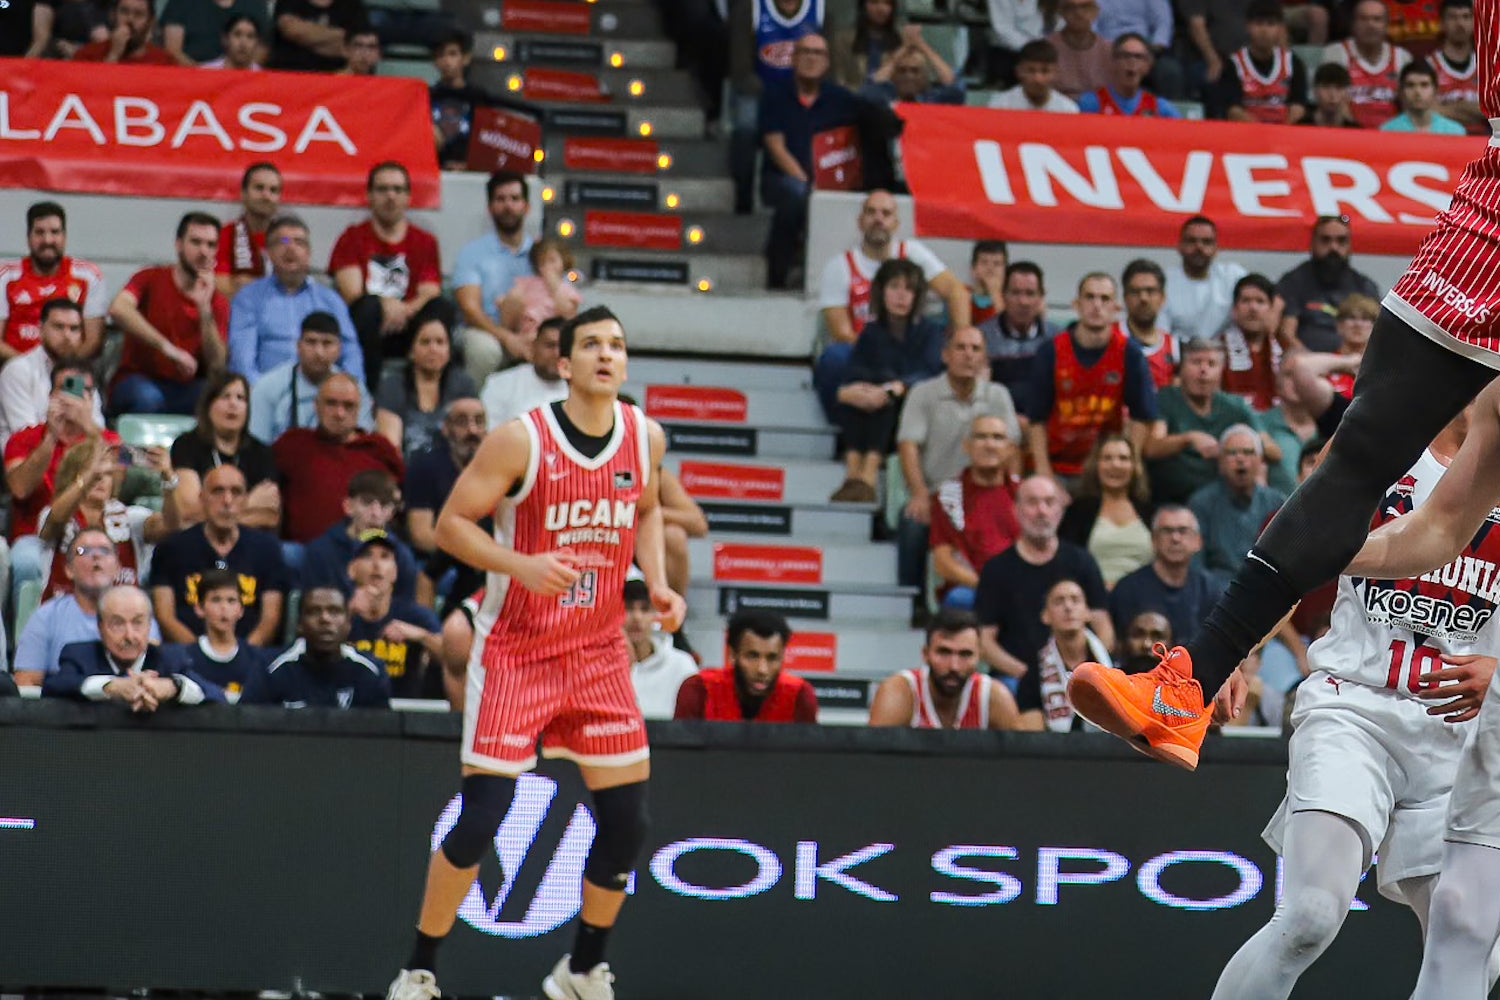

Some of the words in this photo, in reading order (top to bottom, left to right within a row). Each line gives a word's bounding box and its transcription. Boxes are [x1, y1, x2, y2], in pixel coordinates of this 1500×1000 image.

[0, 90, 358, 156] LABASA
[973, 139, 1450, 226] INVERS
[1421, 268, 1491, 325] INVERSUS
[544, 498, 636, 531] UCAM
[556, 528, 621, 547] MURCIA
[1386, 638, 1443, 695] 10
